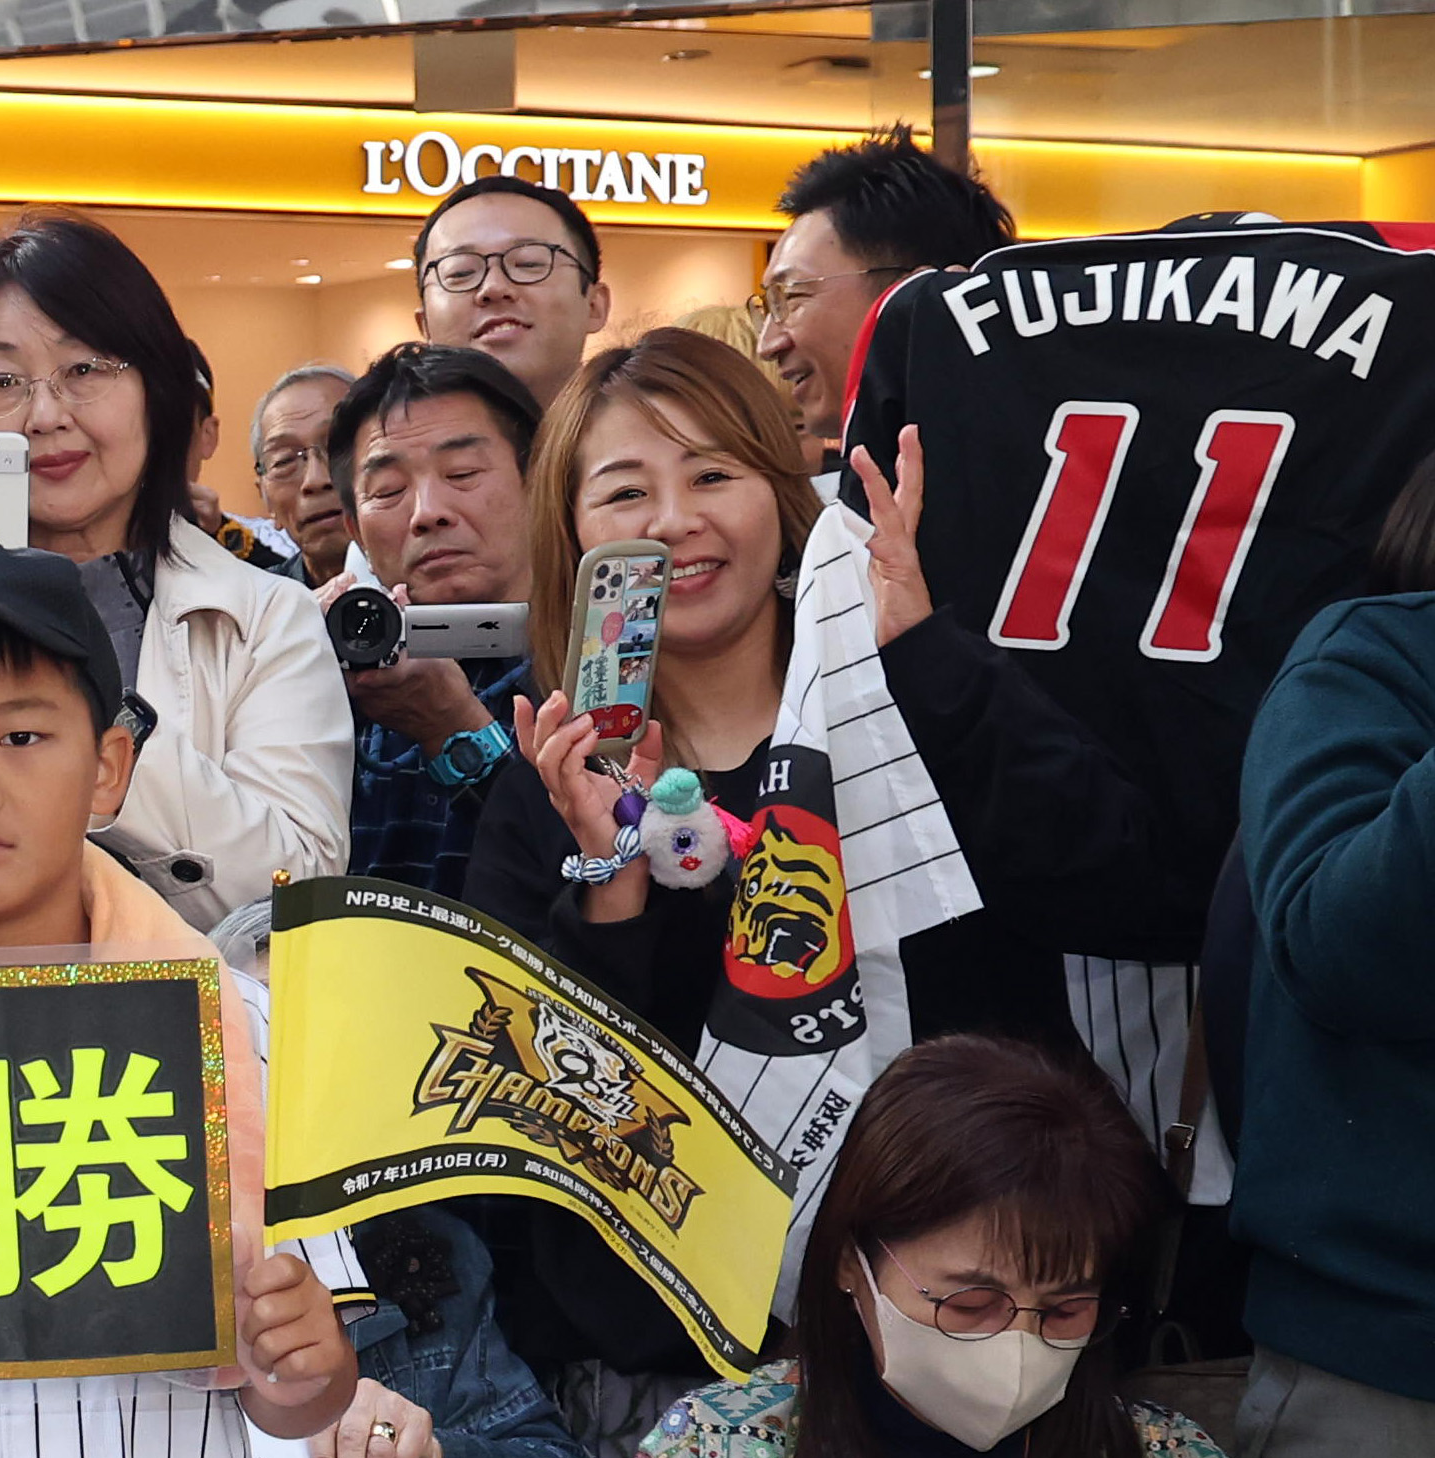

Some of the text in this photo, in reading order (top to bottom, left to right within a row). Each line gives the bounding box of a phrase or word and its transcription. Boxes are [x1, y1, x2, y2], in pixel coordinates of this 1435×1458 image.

[362, 131, 709, 206] L'OCCITANE
[942, 256, 1393, 380] FUJIKAWA
[988, 401, 1295, 662] 11
